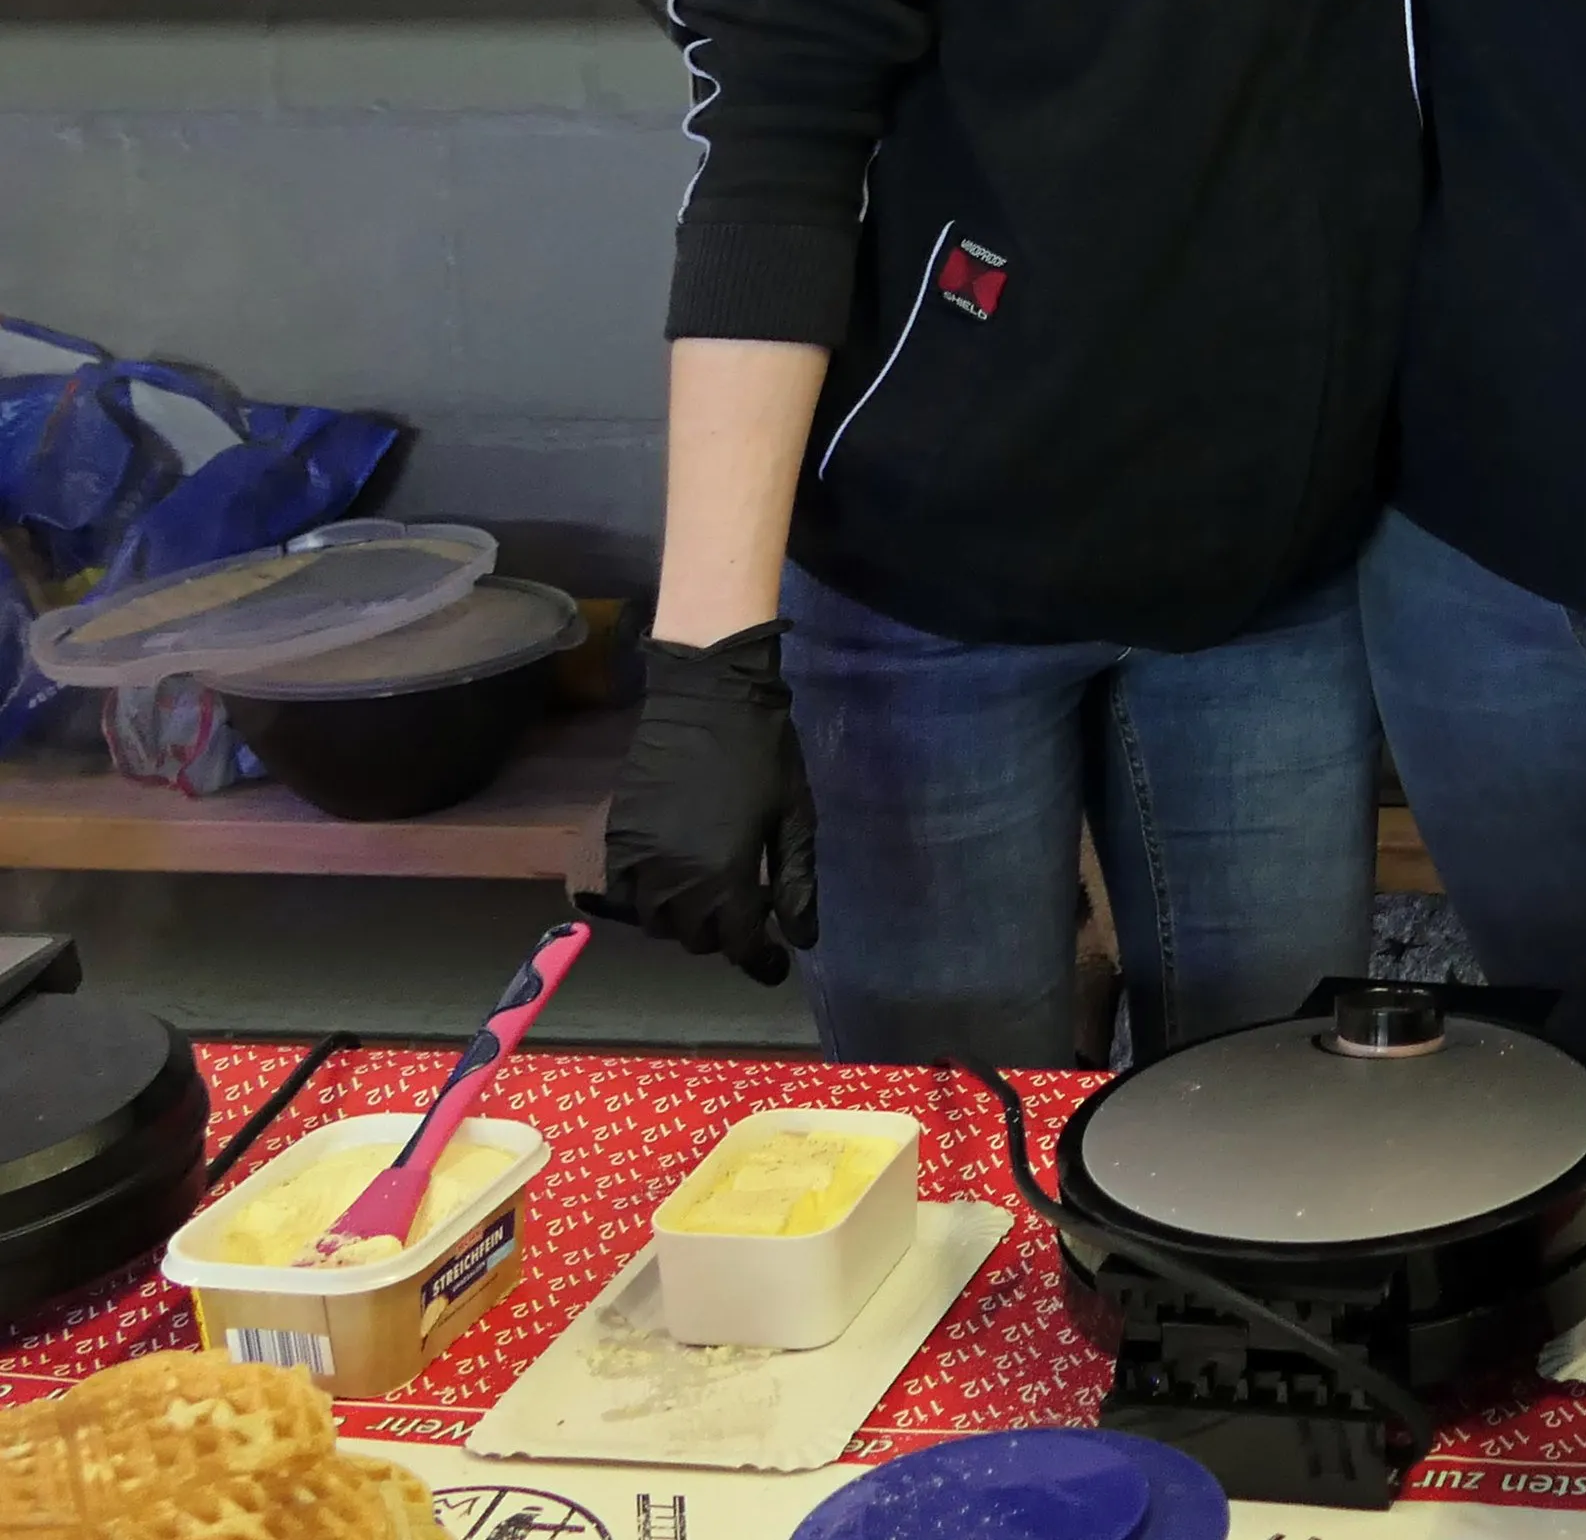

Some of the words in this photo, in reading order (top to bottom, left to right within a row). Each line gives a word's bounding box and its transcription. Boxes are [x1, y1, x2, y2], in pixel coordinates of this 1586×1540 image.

[961, 239, 1008, 268] WINDPROOF
[943, 291, 988, 321] SHIELD
[213, 1051, 257, 1071] 112
[354, 1060, 397, 1074] 112
[400, 1061, 443, 1076] 112
[495, 1064, 537, 1080] 112
[649, 1058, 692, 1069] 112
[696, 1060, 739, 1073] 112
[743, 1061, 786, 1075] 112
[790, 1062, 833, 1076] 112
[838, 1065, 881, 1079] 112
[541, 1066, 585, 1082] 112
[588, 1068, 632, 1083] 112
[636, 1070, 680, 1085] 112
[684, 1074, 727, 1087] 112
[732, 1076, 775, 1089] 112
[780, 1077, 824, 1092] 112
[884, 1066, 928, 1082] 112
[1029, 1070, 1072, 1087] 112
[225, 1075, 269, 1101] 112
[318, 1076, 363, 1104] 112
[365, 1078, 410, 1105] 112
[508, 1083, 552, 1110] 112
[556, 1085, 600, 1111] 112
[604, 1087, 648, 1112] 112
[828, 1081, 872, 1095] 112
[876, 1083, 920, 1099] 112
[924, 1084, 968, 1101] 112
[1022, 1089, 1065, 1109] 112
[652, 1089, 697, 1113] 112
[700, 1090, 745, 1114] 112
[749, 1093, 793, 1112] 112
[945, 1104, 989, 1121] 112
[208, 1105, 253, 1125] 112
[544, 1115, 589, 1139] 112
[592, 1116, 637, 1141] 112
[641, 1117, 686, 1143] 112
[936, 1124, 981, 1149] 112
[559, 1143, 604, 1163] 112
[608, 1145, 654, 1166] 112
[658, 1147, 703, 1171] 112
[545, 1166, 591, 1187] 112
[958, 1153, 1004, 1180] 112
[595, 1168, 642, 1190] 112
[561, 1189, 603, 1208] 112
[612, 1190, 655, 1210] 112
[546, 1210, 594, 1236] 112
[598, 1213, 646, 1240] 112
[432, 1225, 505, 1298] STREICHFEIN
[563, 1243, 611, 1265] 112
[548, 1269, 597, 1291] 112
[986, 1260, 1034, 1285] 112
[119, 1301, 169, 1328] 112
[511, 1293, 560, 1318] 112
[495, 1321, 545, 1346] 112
[946, 1314, 995, 1339] 112
[1001, 1317, 1049, 1342] 112
[75, 1330, 127, 1355] 112
[0, 1353, 51, 1371] 112
[456, 1348, 507, 1375] 112
[936, 1344, 986, 1367] 112
[993, 1346, 1041, 1369] 112
[53, 1359, 104, 1377] 112
[903, 1370, 954, 1395] 112
[960, 1372, 1010, 1399] 112
[893, 1400, 944, 1427] 112
[951, 1404, 1001, 1429] 112
[1482, 1400, 1531, 1426] 112
[365, 1416, 475, 1440] Wehr
[1480, 1430, 1529, 1456] 112
[1412, 1469, 1485, 1491] zur
